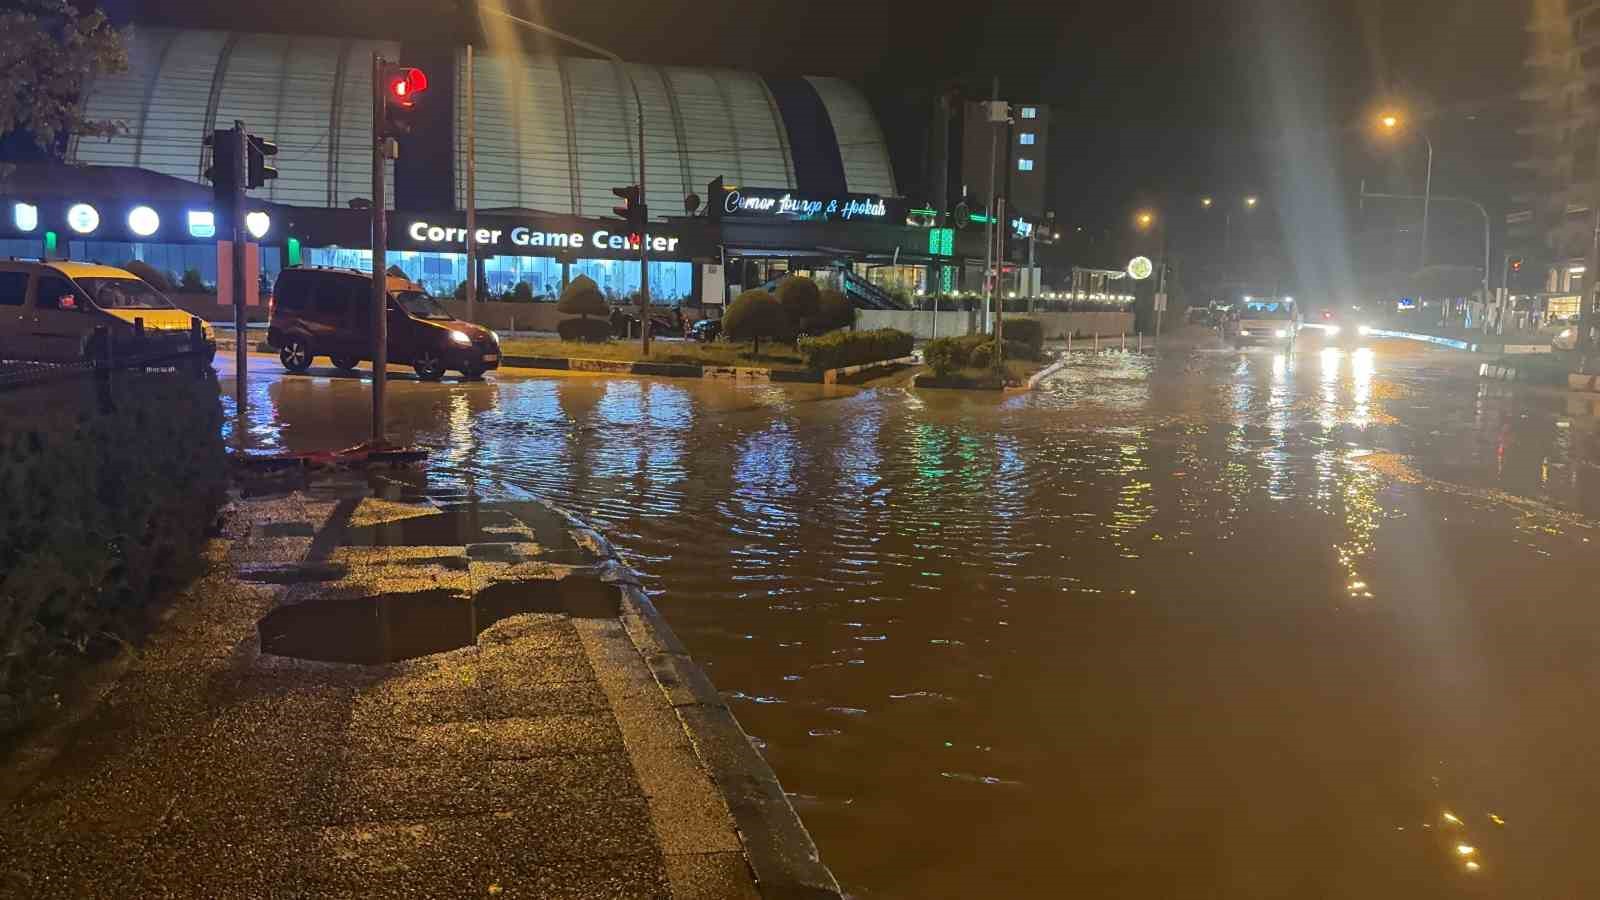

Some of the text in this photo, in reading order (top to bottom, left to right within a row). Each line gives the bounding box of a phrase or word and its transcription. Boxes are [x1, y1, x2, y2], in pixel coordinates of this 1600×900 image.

[827, 198, 838, 213] &
[841, 198, 886, 219] Hookah
[409, 221, 679, 252] Corner Game Center
